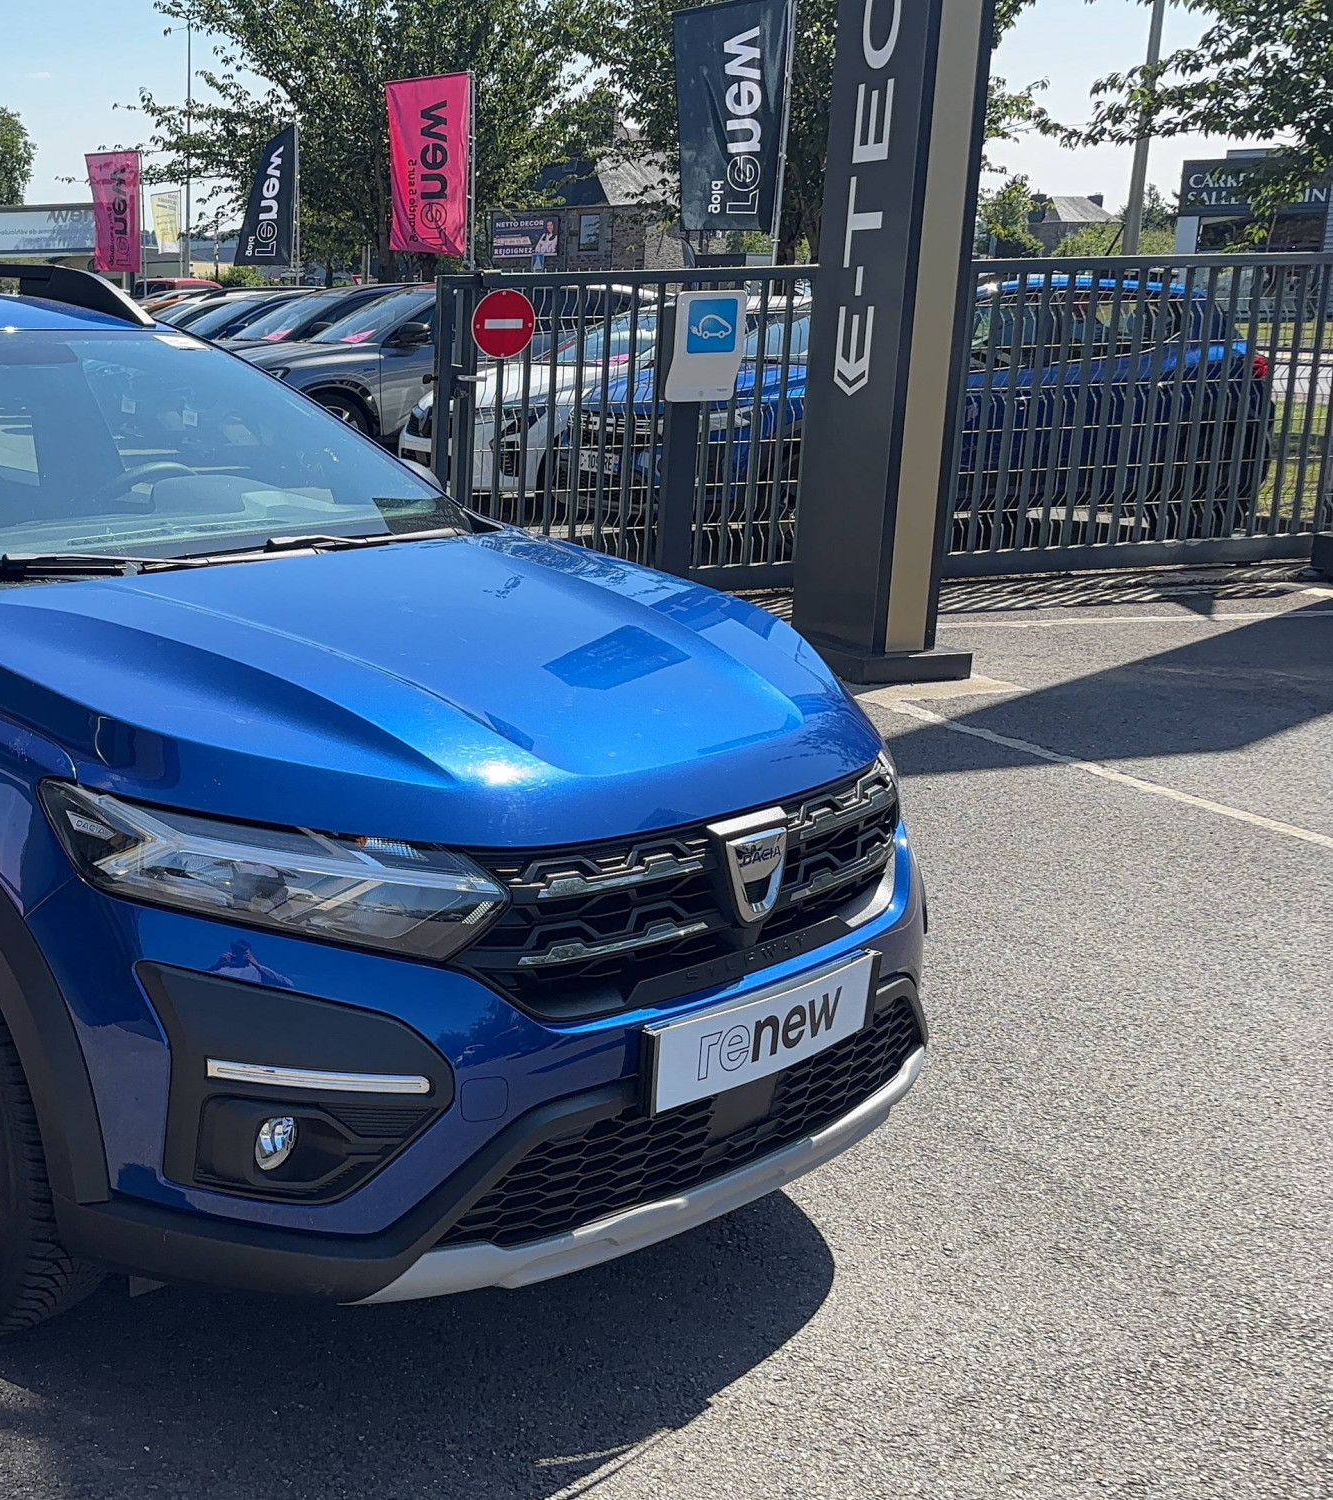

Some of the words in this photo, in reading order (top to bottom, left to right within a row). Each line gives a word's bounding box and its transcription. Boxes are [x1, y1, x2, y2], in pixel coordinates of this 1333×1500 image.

[76, 820, 105, 835] DACIA
[741, 845, 781, 867] DACIA
[698, 985, 843, 1081] renew
